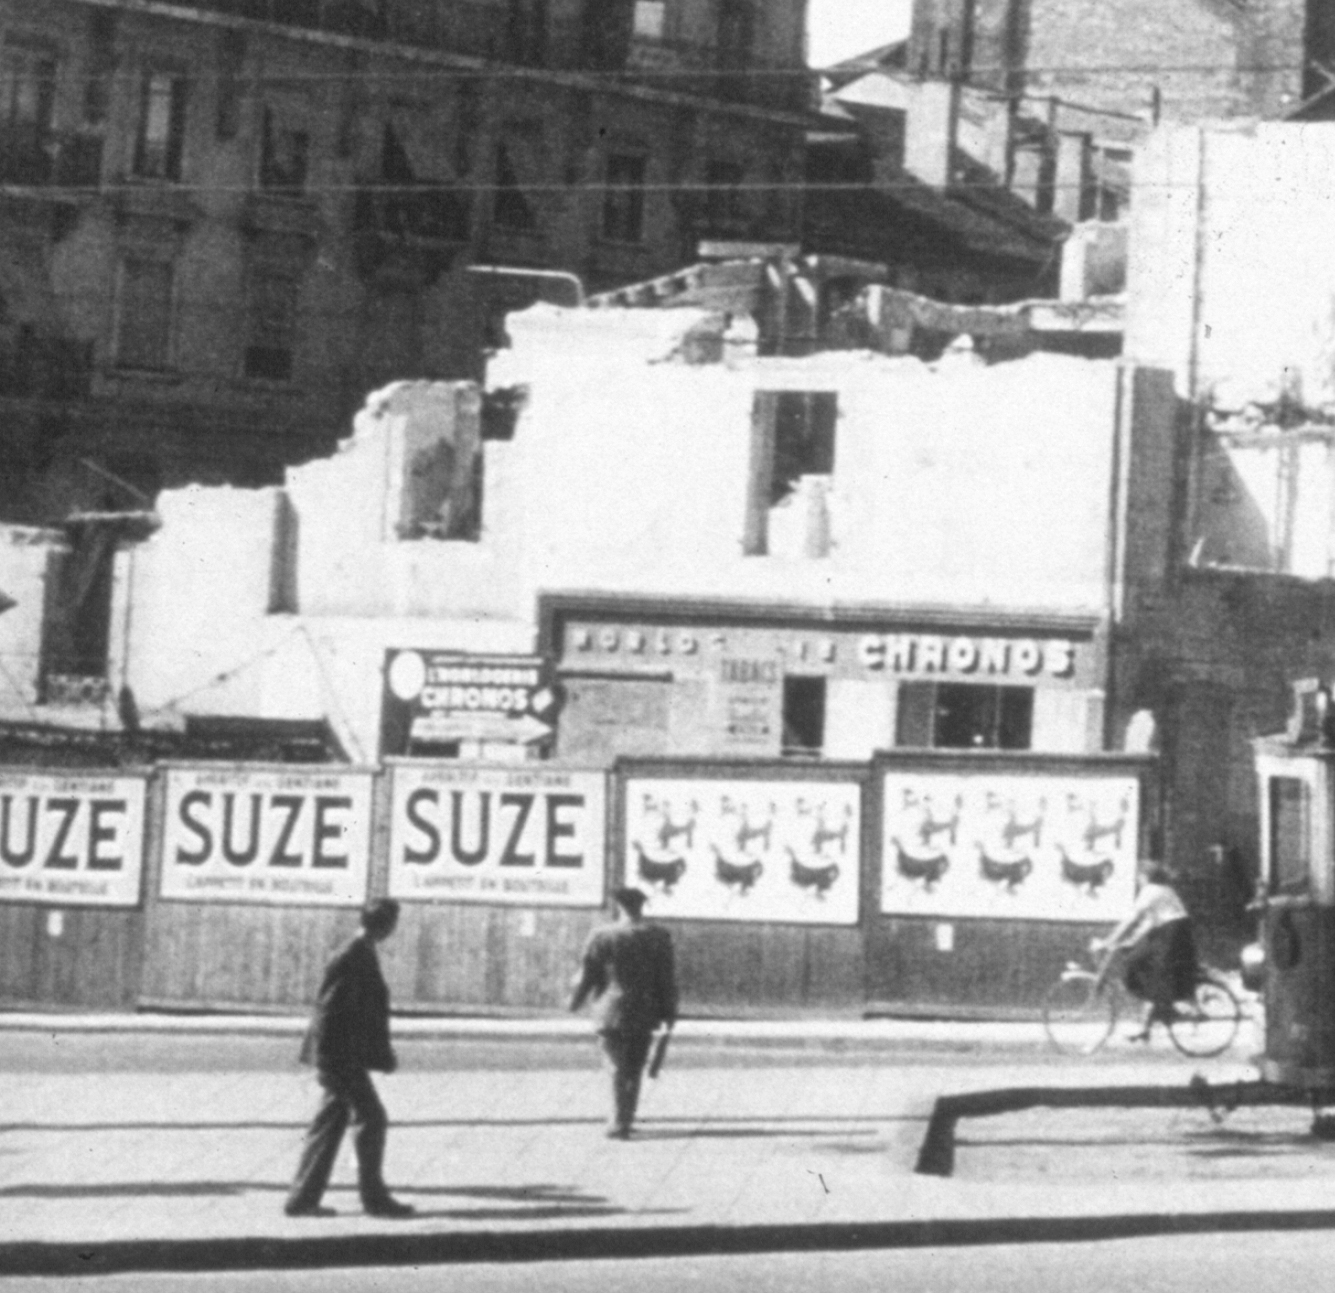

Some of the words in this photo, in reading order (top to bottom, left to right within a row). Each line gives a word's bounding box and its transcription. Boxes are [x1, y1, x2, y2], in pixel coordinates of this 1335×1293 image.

[858, 634, 1077, 677] CHRONOS
[420, 685, 529, 711] CHRONOS
[176, 790, 353, 869] SUZE
[404, 788, 586, 868] SUZE
